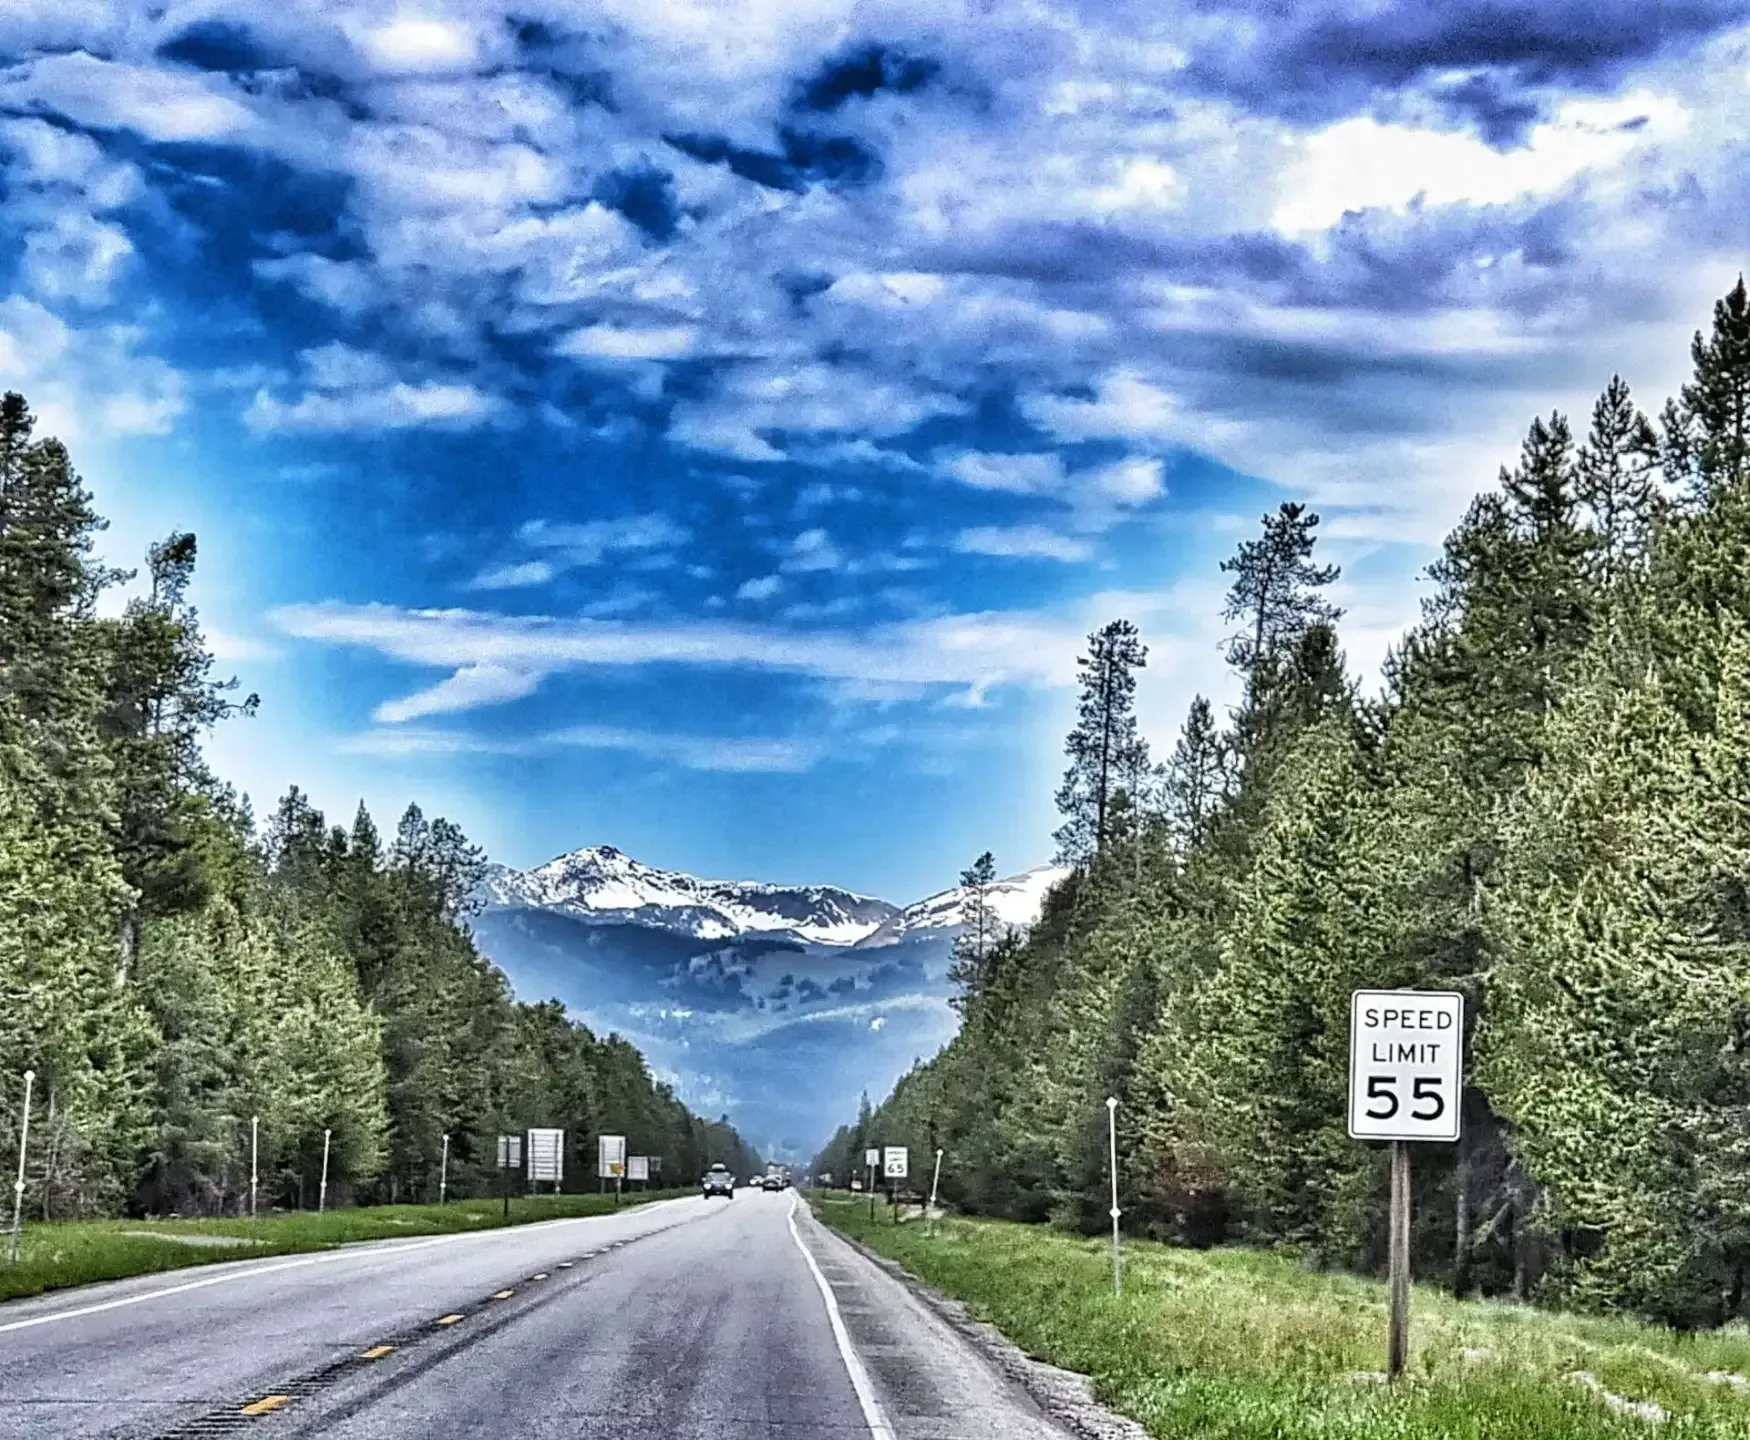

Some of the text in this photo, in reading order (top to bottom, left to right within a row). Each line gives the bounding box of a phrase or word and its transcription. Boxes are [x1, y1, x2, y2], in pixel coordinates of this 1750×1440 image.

[1364, 1008, 1452, 1030] SPEED
[1372, 1043, 1441, 1064] LIMIT
[1365, 1076, 1445, 1121] 55
[887, 1163, 904, 1173] 65
